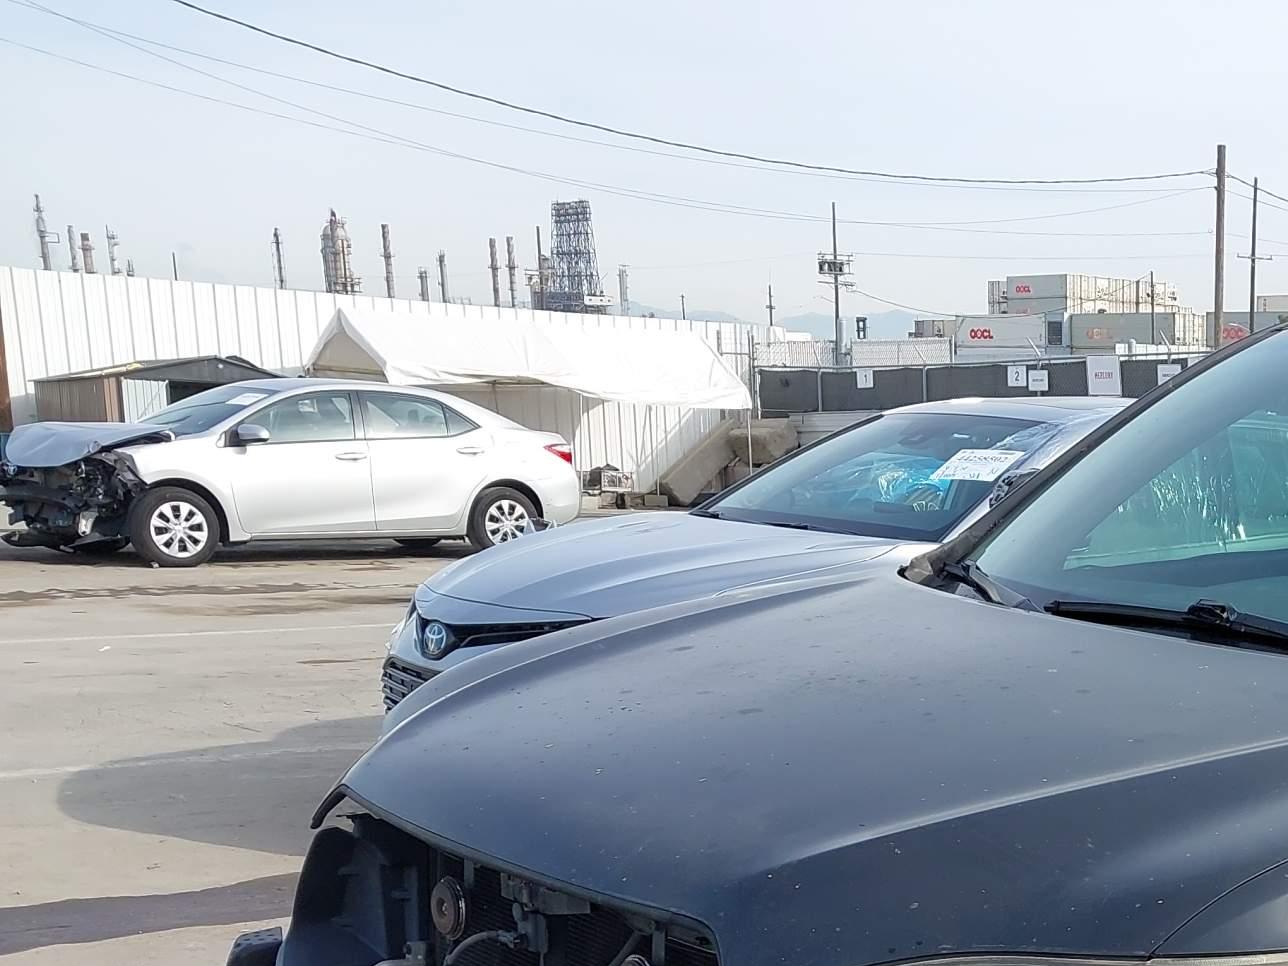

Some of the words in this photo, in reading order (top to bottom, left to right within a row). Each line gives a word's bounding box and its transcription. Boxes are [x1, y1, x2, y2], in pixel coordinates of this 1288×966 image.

[1015, 285, 1031, 293] OOCL
[969, 328, 994, 339] OOCL
[1014, 370, 1020, 382] 2
